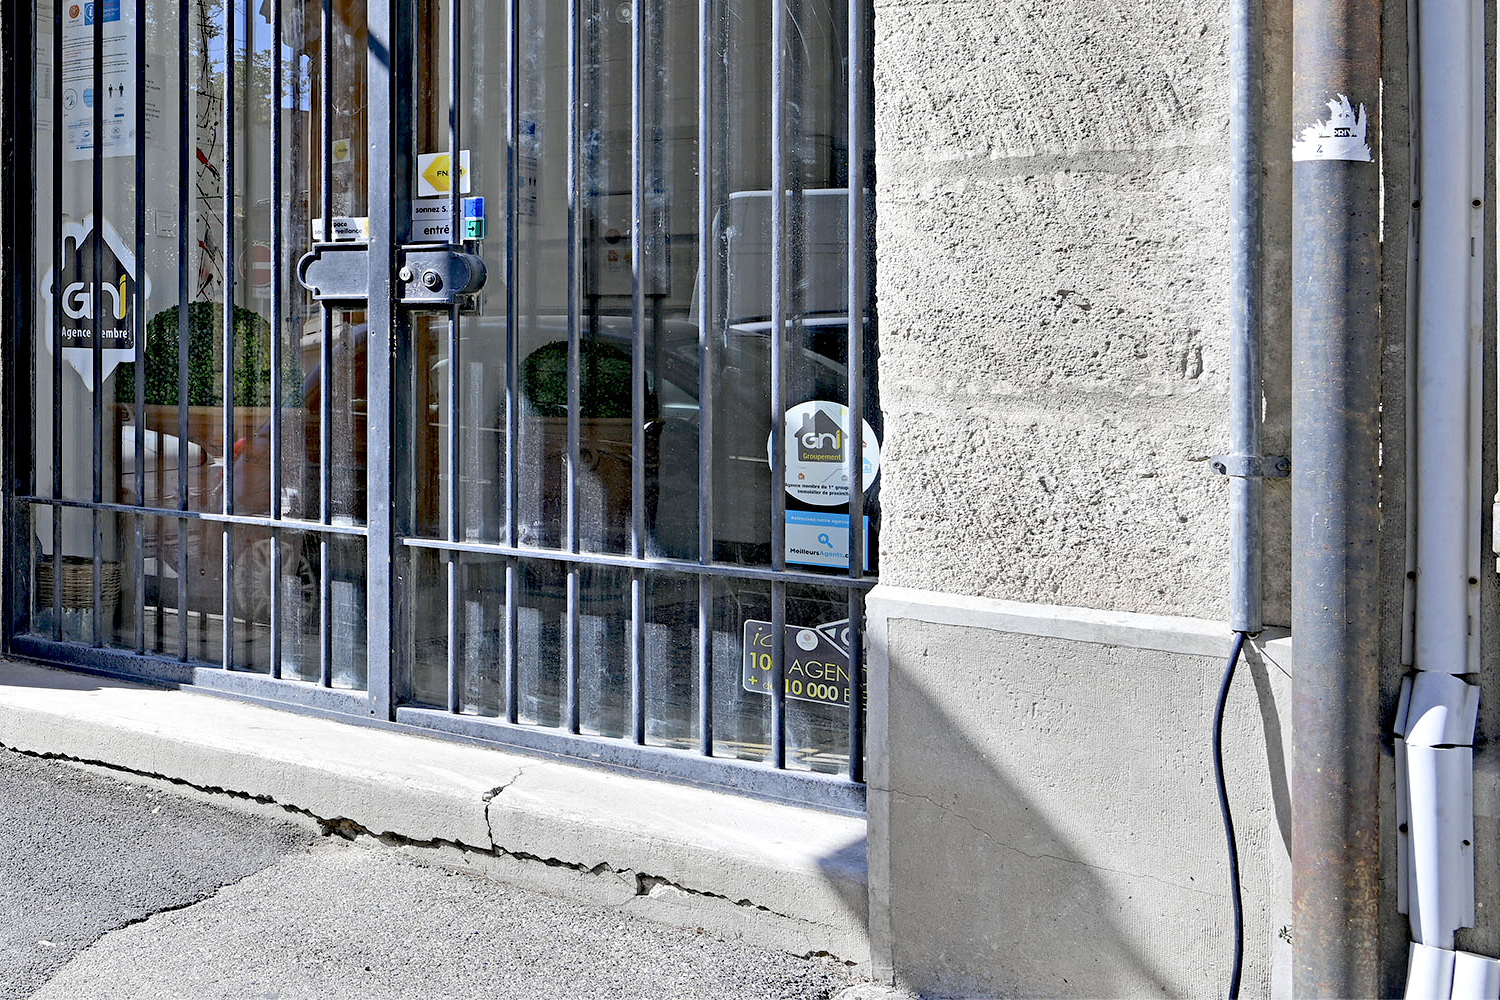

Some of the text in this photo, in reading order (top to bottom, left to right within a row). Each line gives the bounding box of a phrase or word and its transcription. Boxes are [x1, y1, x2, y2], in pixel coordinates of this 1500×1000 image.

[423, 224, 450, 236] entré
[61, 327, 128, 339] Agence embre
[803, 452, 842, 461] Groupement
[790, 547, 849, 559] MeilleursAgents.c
[788, 659, 850, 682] AGEN
[806, 682, 839, 701] 000
